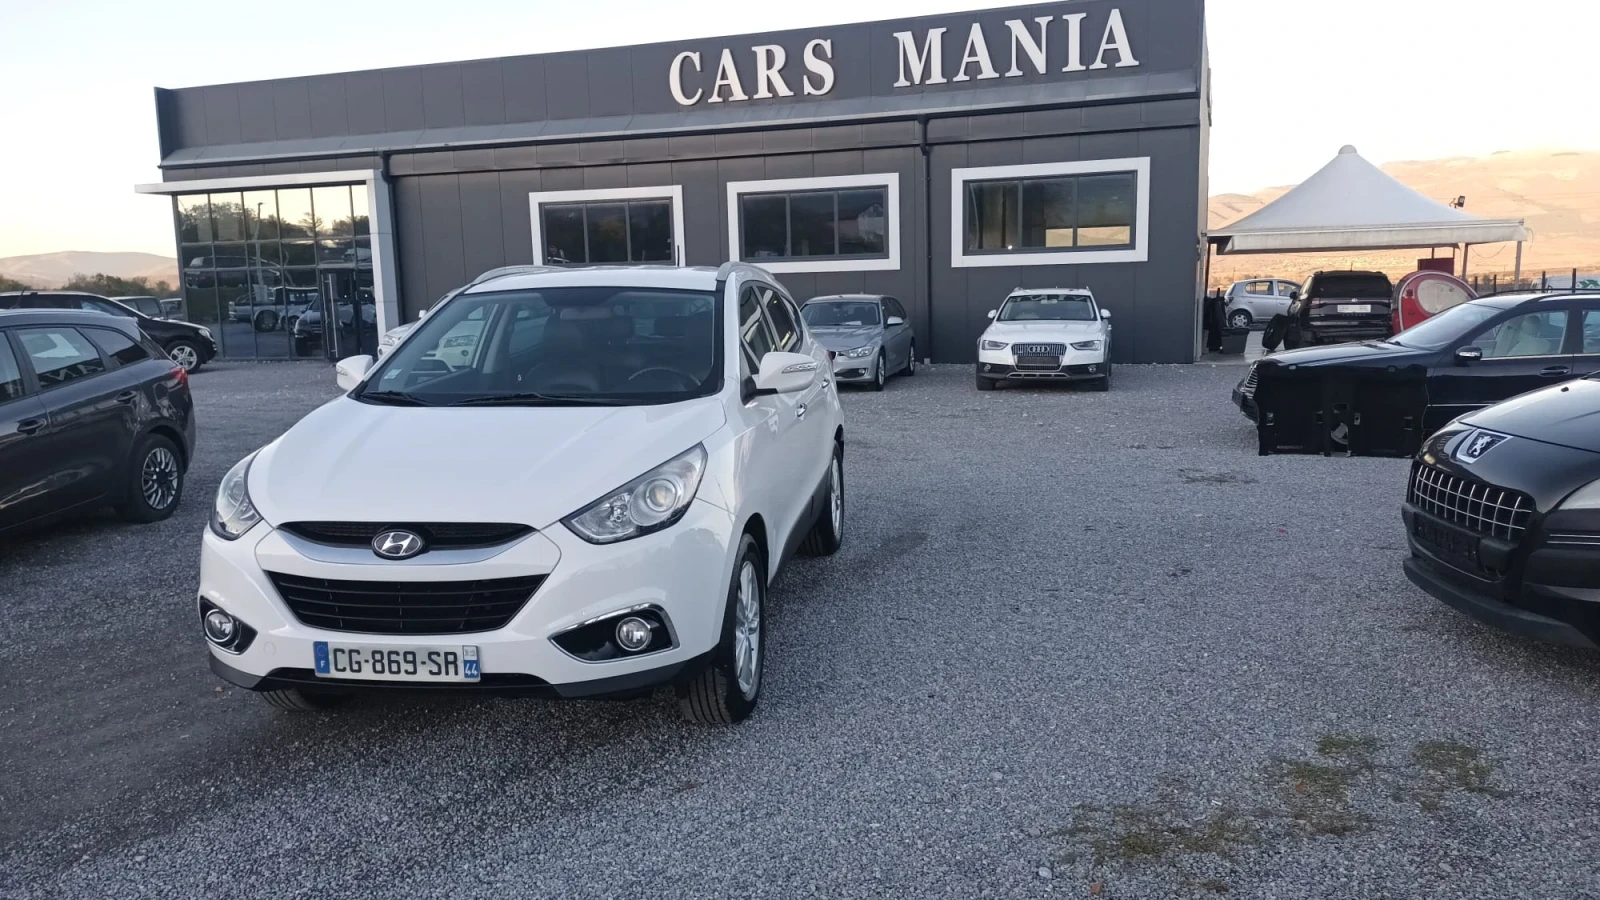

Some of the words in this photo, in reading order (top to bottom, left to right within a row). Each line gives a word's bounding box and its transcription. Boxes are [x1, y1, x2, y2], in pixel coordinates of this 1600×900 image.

[669, 38, 835, 106] CARS
[892, 8, 1140, 88] MANIA
[320, 660, 326, 669] F
[333, 647, 459, 677] CG-869-SR
[464, 662, 479, 676] 44
